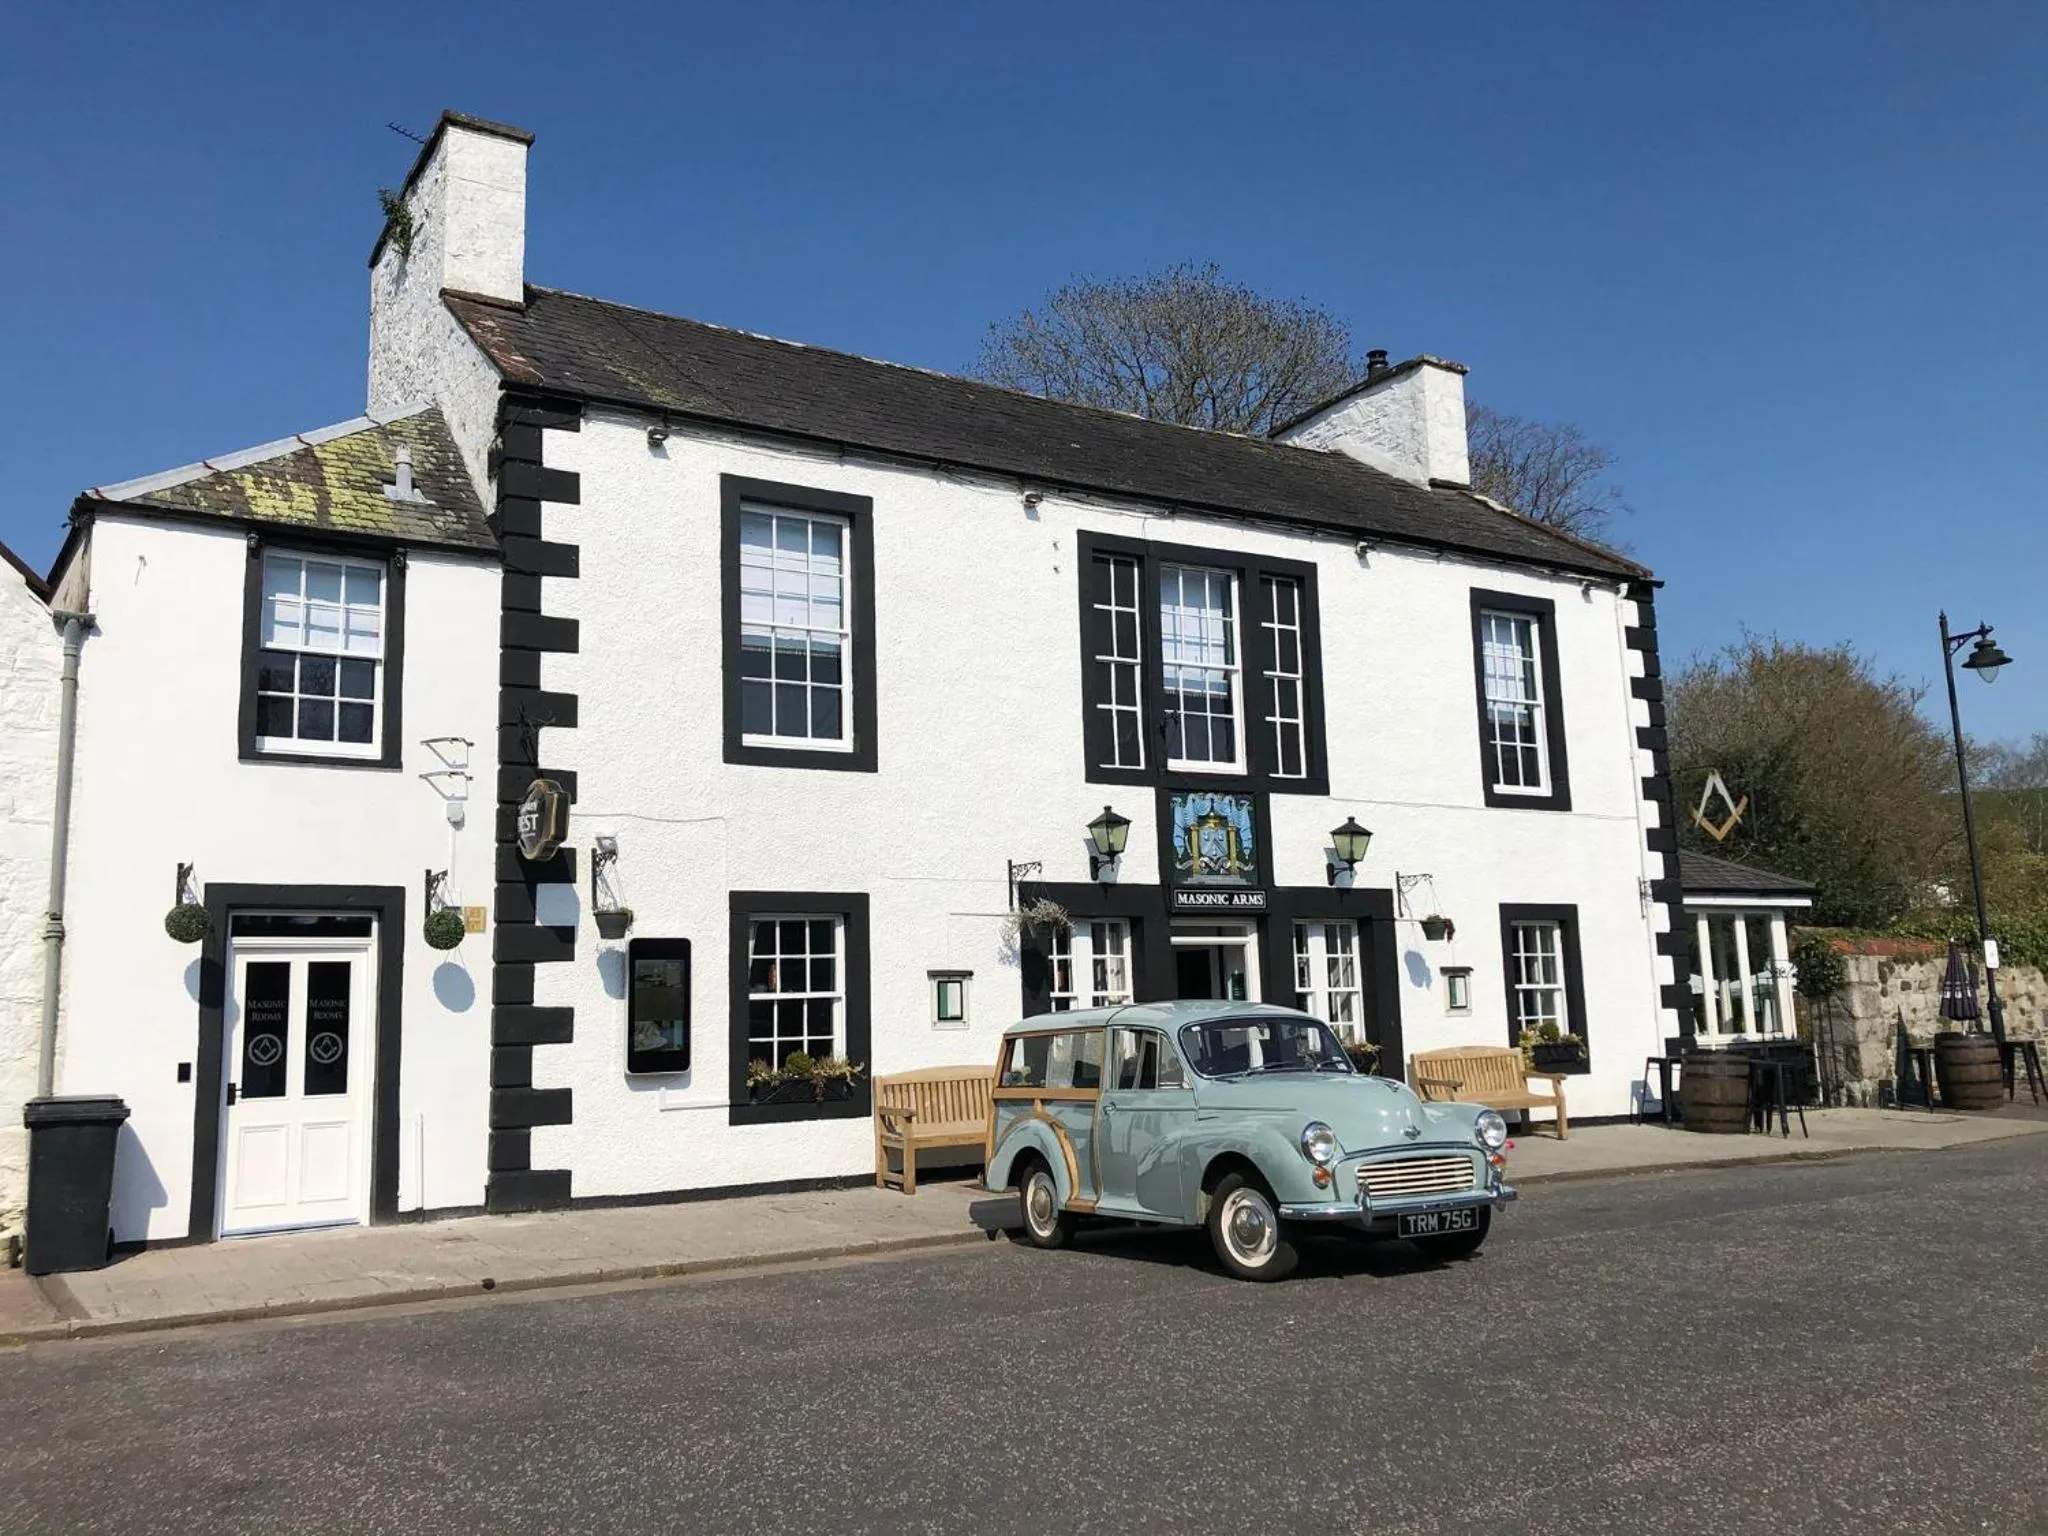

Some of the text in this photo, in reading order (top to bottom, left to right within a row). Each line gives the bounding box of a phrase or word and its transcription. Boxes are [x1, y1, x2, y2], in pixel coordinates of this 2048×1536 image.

[1177, 893, 1264, 905] MASONIC ARMS
[247, 1000, 286, 1009] MASONIC
[309, 1000, 346, 1008] MASONIC
[251, 1012, 282, 1021] ROOMS
[313, 1010, 343, 1020] ROOMS
[1406, 1209, 1471, 1233] TRM 75G
